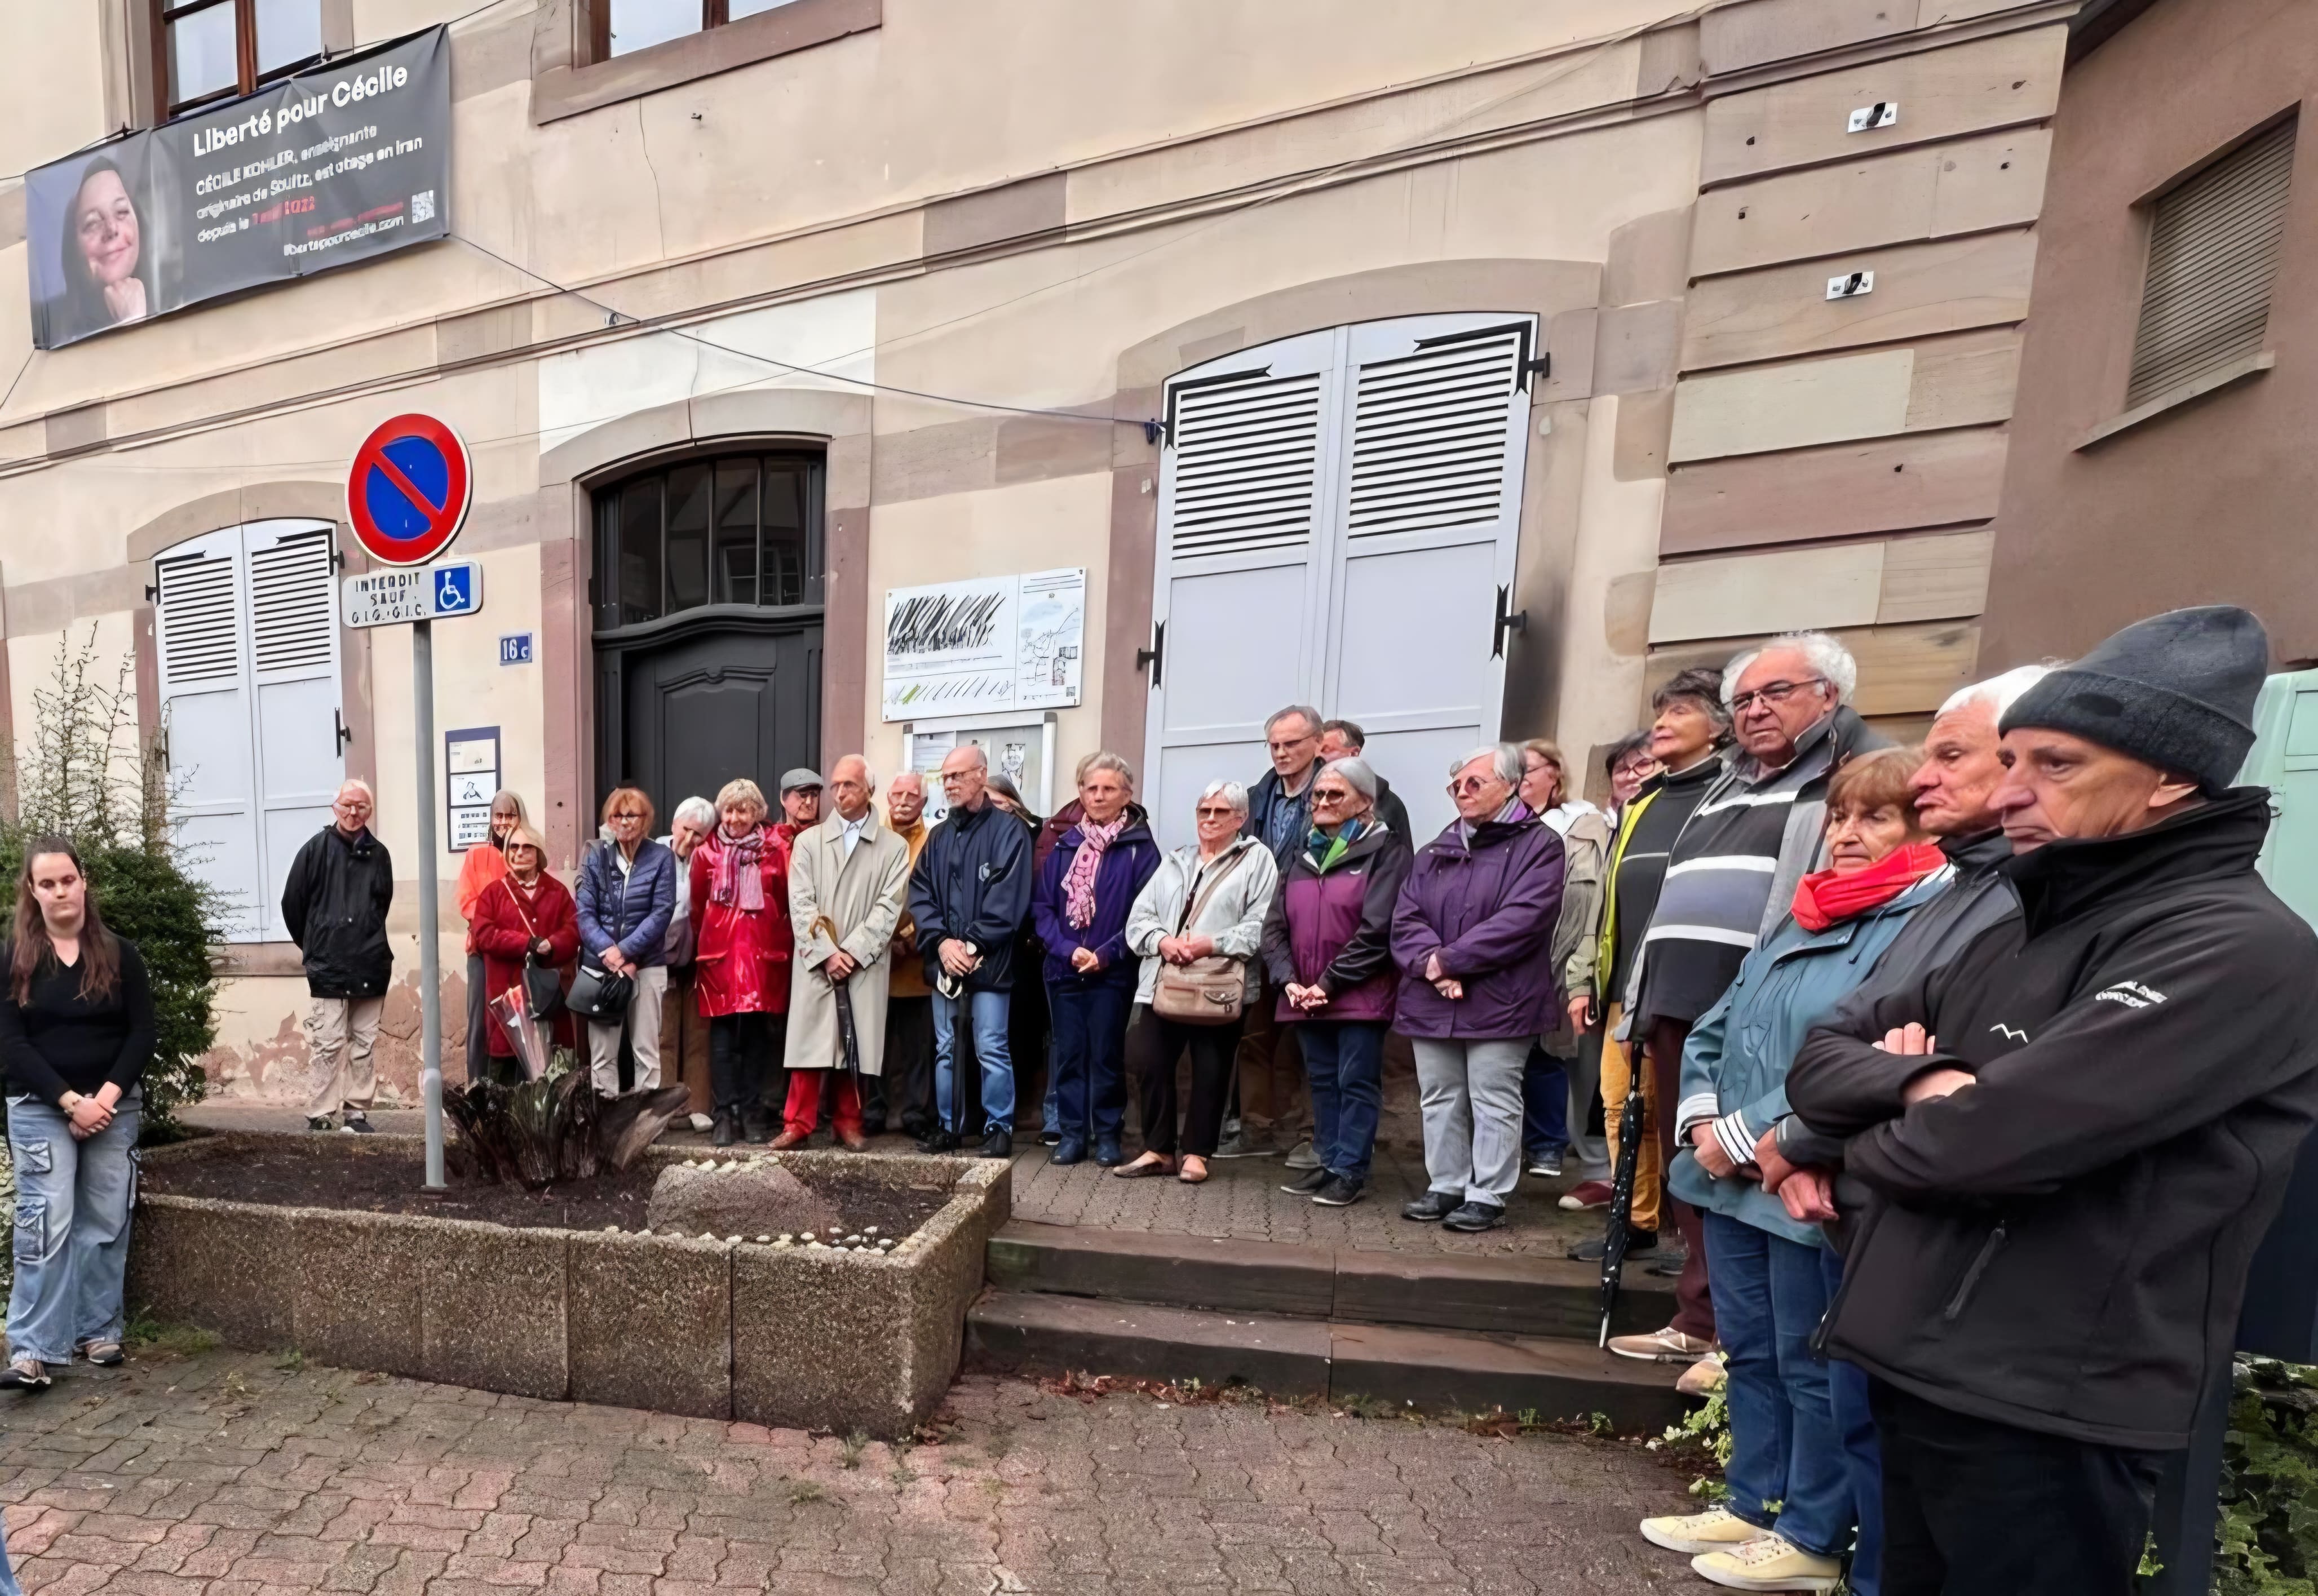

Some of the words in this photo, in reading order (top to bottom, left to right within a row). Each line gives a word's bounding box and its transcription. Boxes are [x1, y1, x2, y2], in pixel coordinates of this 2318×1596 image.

[194, 109, 271, 157] Liberté
[277, 93, 328, 134] pour
[332, 65, 408, 108] Cécile
[253, 188, 267, 202] de
[377, 146, 393, 161] en
[396, 138, 422, 155] Iran
[356, 572, 420, 592] INTERDIT
[370, 589, 405, 607] SAUF
